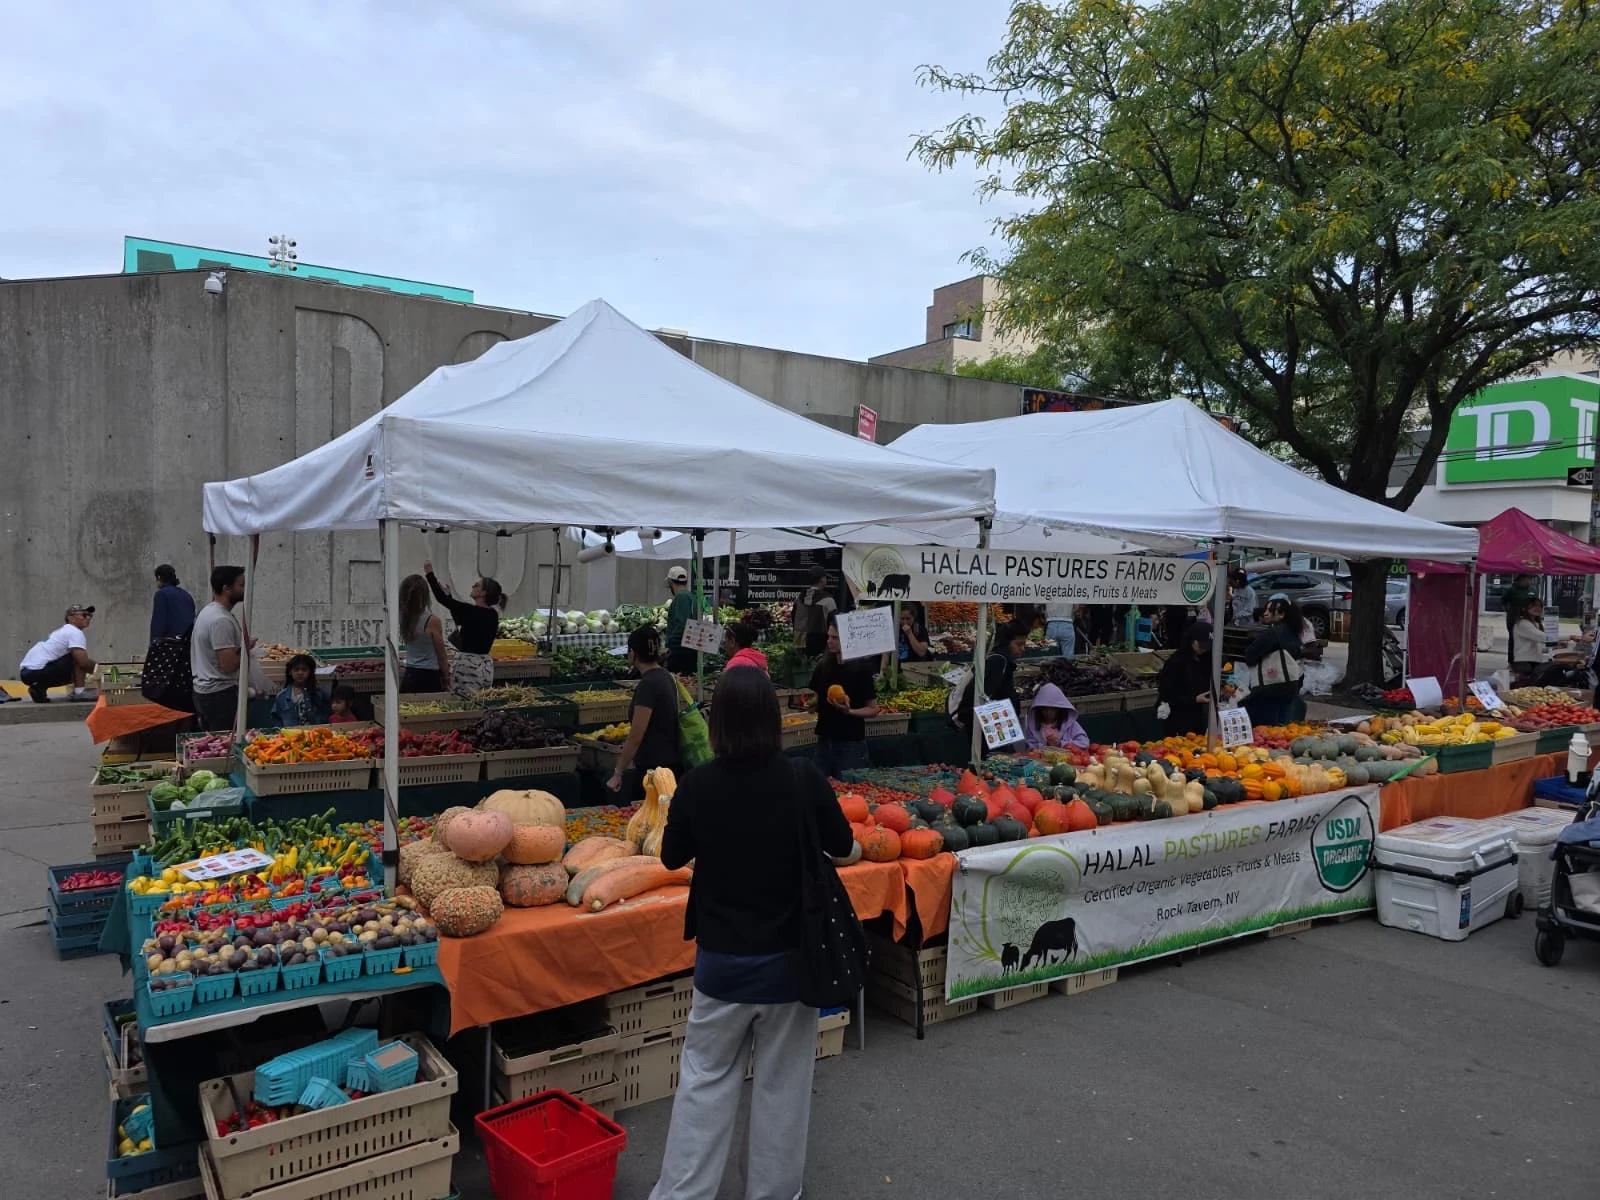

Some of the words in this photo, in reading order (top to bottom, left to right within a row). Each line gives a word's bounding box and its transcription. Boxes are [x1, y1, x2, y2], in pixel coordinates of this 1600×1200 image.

[1458, 400, 1551, 462] TD
[921, 552, 998, 576] HALAL
[1005, 555, 1108, 579] PASTURES
[1115, 560, 1177, 582] FARMS
[934, 581, 987, 596] Certified
[991, 582, 1031, 600] Organic
[1034, 583, 1090, 600] Vegetables,
[1093, 585, 1120, 598] Fruits
[1122, 586, 1128, 598] &
[1131, 586, 1158, 599] Meats
[293, 619, 333, 646] THE
[1326, 817, 1361, 840] USDA
[1083, 844, 1156, 876] HALAL
[1164, 824, 1262, 863] PASTURES
[1265, 813, 1320, 843] FARMS
[1323, 844, 1363, 867] ORGANIC
[1084, 881, 1135, 904] Certified
[1136, 875, 1177, 894] Organic
[1180, 863, 1233, 887] Vegetables,
[1236, 858, 1262, 874] Fruits
[1264, 856, 1271, 867] &
[1273, 851, 1300, 866] Meats
[1157, 903, 1183, 921] Rock
[1186, 898, 1223, 914] Tavern,
[1226, 890, 1240, 906] NY
